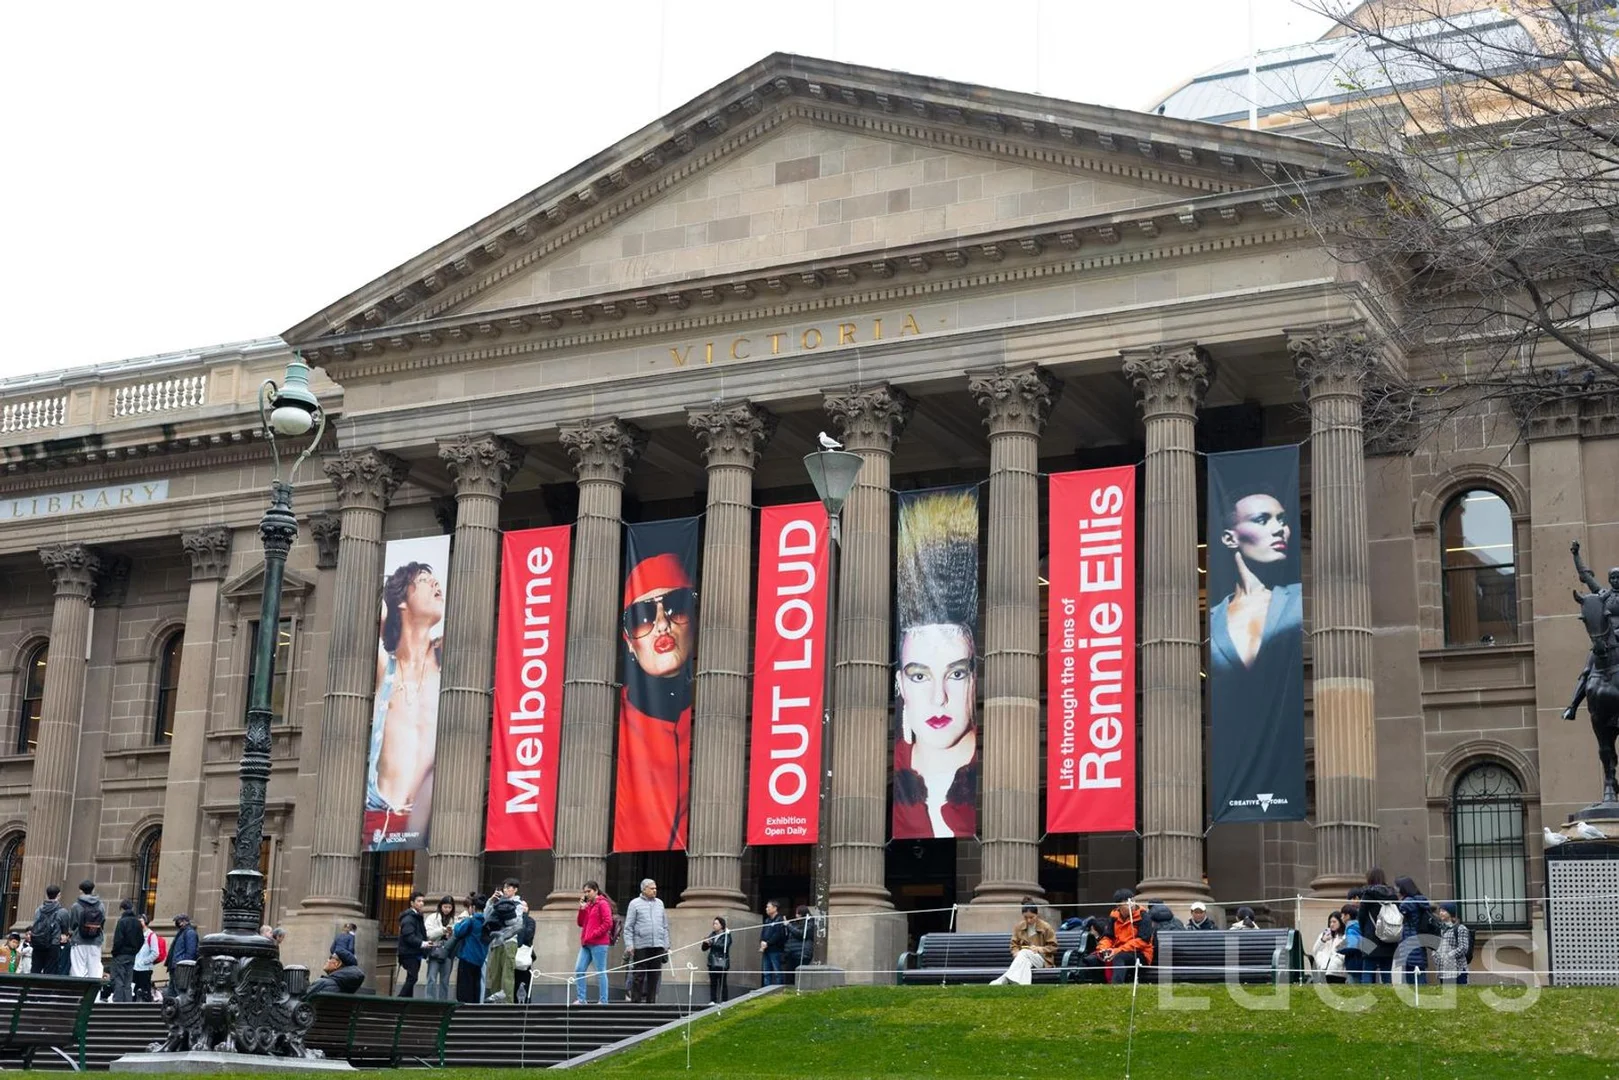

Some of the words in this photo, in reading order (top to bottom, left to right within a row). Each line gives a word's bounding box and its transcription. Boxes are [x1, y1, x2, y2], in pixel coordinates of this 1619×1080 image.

[670, 313, 921, 367] VICTORIA
[12, 484, 160, 518] LIBRARY
[1079, 484, 1124, 593] Ellis
[773, 519, 816, 671] LOUD
[1061, 597, 1075, 615] of
[1060, 618, 1075, 654] lens
[505, 546, 553, 814] Melbourne
[1061, 656, 1075, 685] the
[1078, 601, 1123, 790] Rennie
[1060, 687, 1078, 755] through
[768, 685, 811, 805] OUT
[1060, 758, 1074, 790] Life
[764, 827, 785, 836] Open
[786, 827, 807, 836] Daily
[766, 816, 807, 825] Exhibition
